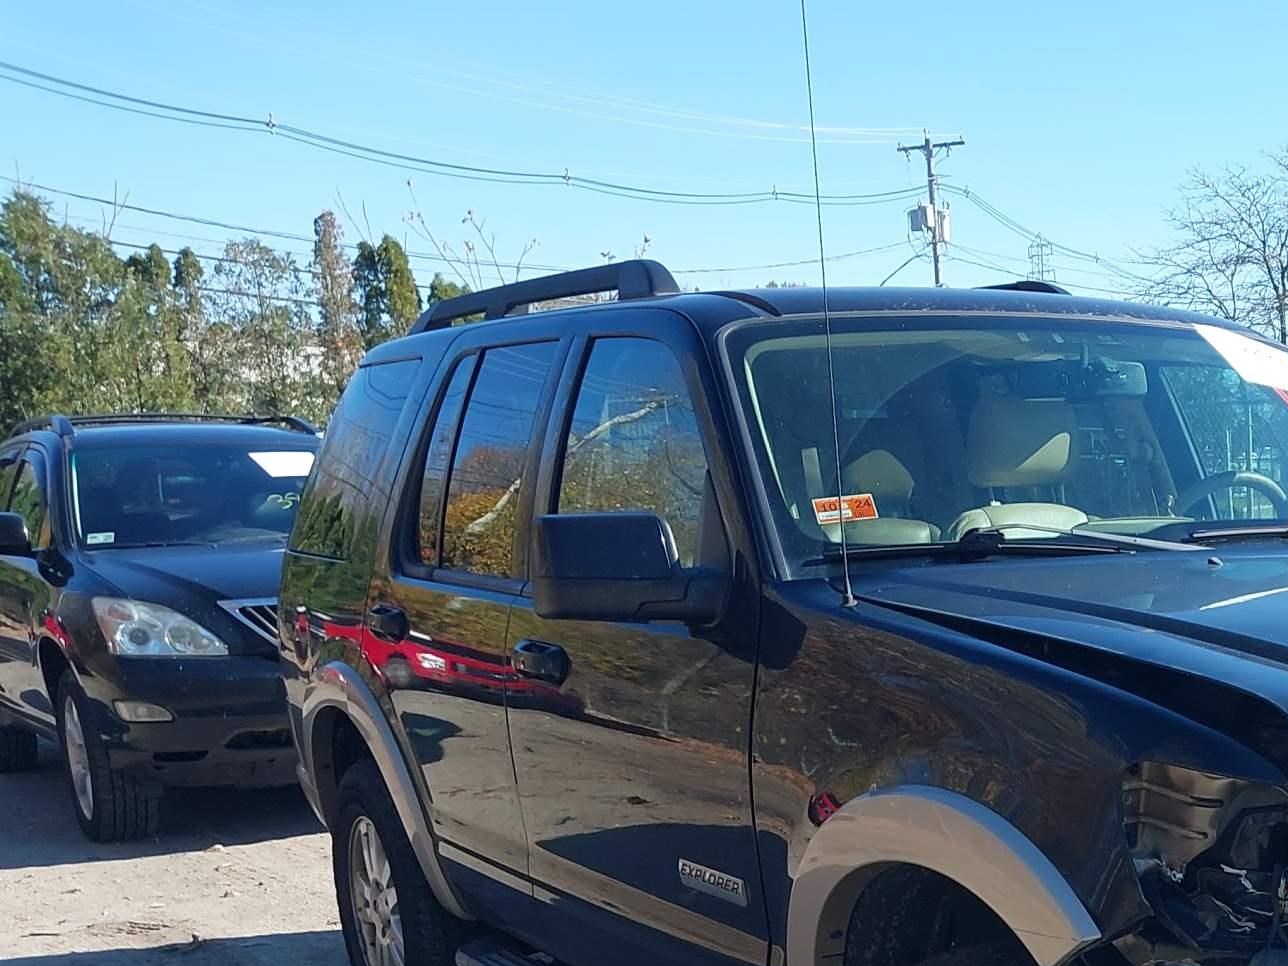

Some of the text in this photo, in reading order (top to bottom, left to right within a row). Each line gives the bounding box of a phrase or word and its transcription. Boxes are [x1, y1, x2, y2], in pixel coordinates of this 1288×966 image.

[822, 499, 872, 512] 10 24
[680, 862, 740, 895] EXPLORER
